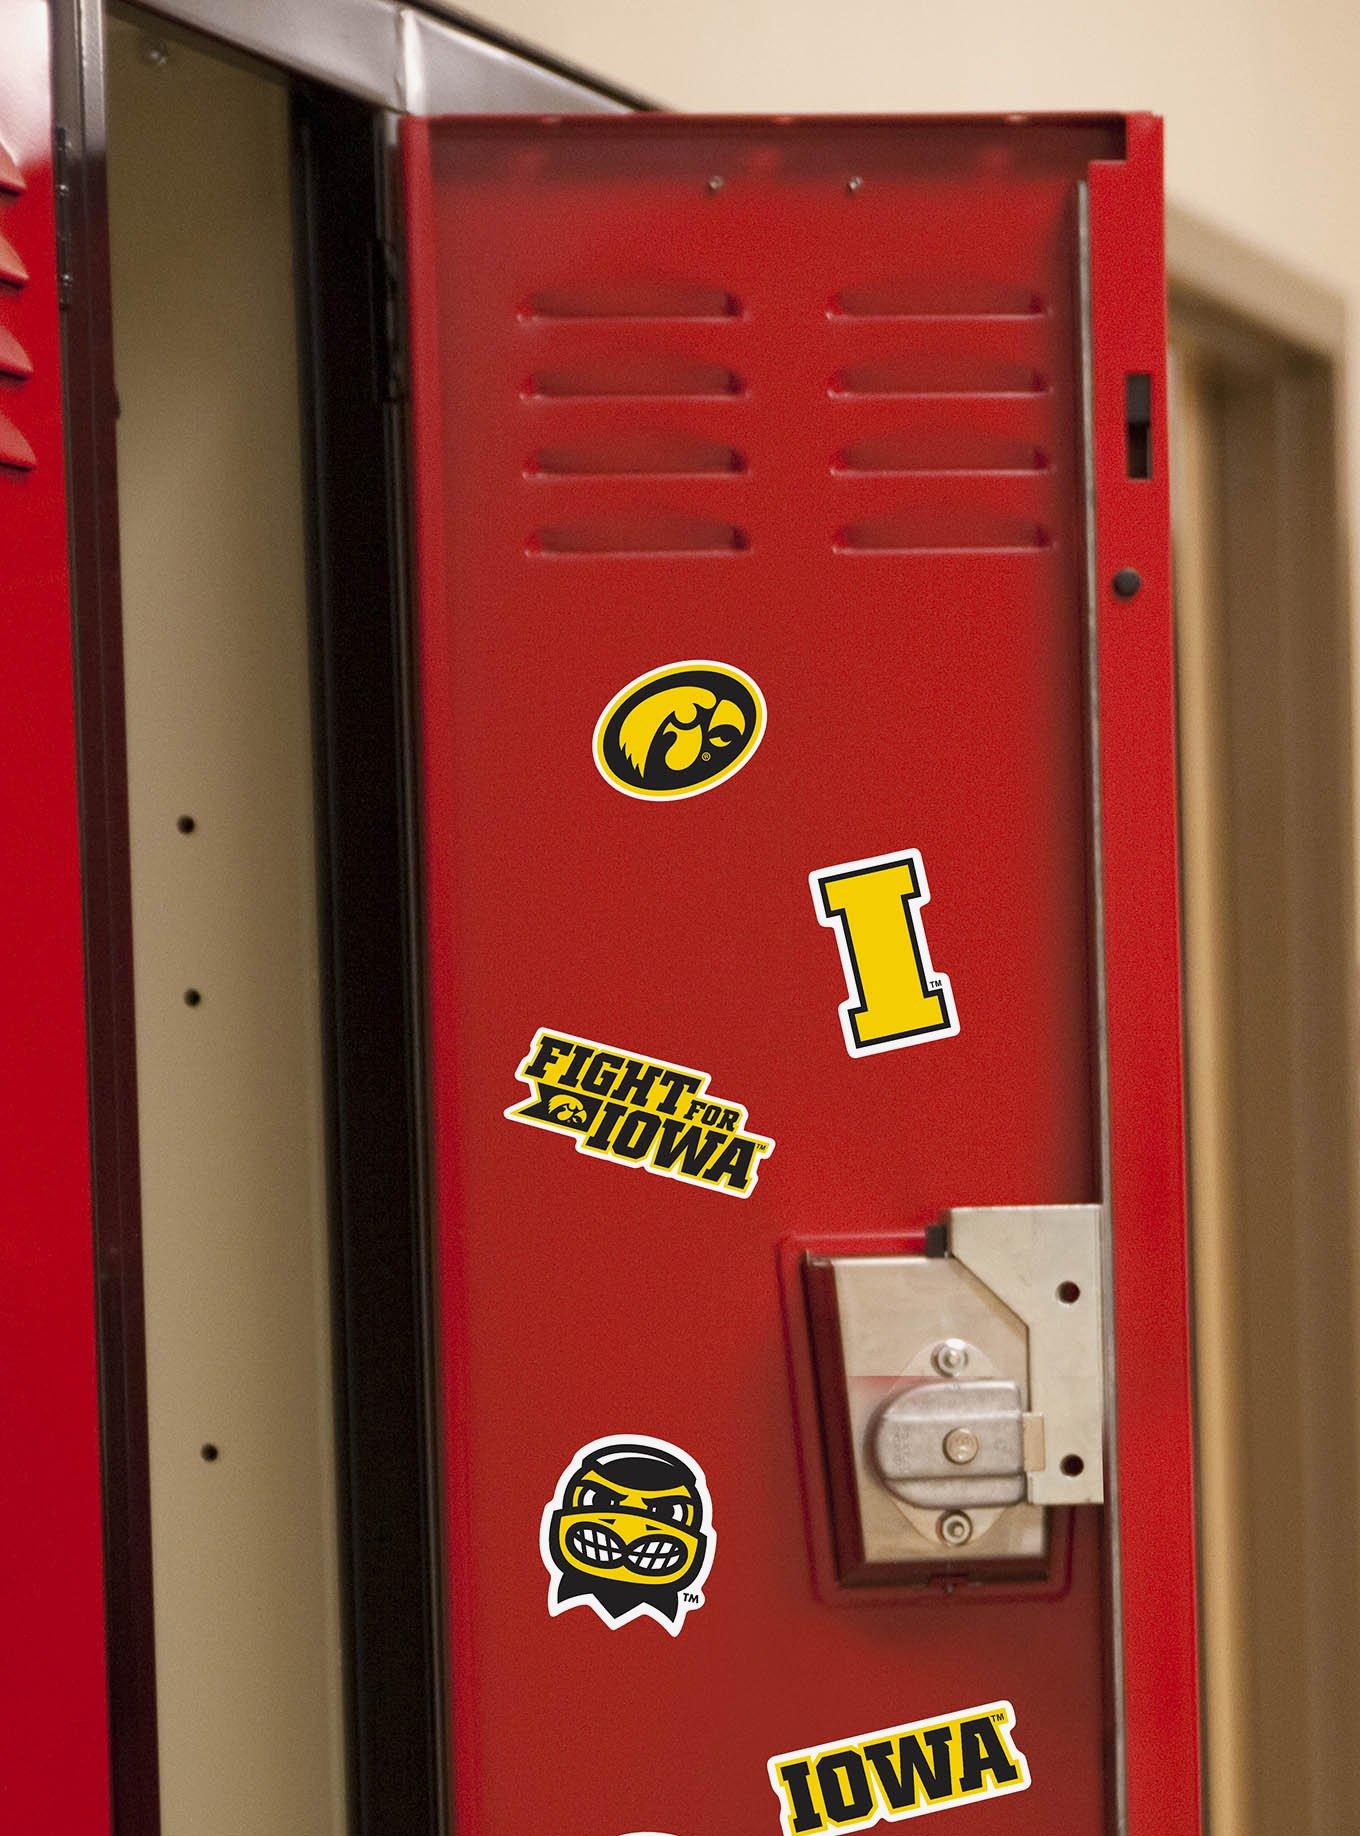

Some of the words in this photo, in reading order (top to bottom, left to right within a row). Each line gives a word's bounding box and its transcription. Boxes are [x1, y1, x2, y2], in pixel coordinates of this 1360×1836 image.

[818, 857, 951, 1049] I
[525, 1035, 703, 1114] FIGHT
[684, 1100, 740, 1131] FOR
[585, 1103, 756, 1189] IOWA
[780, 1716, 1018, 1833] IOWA
